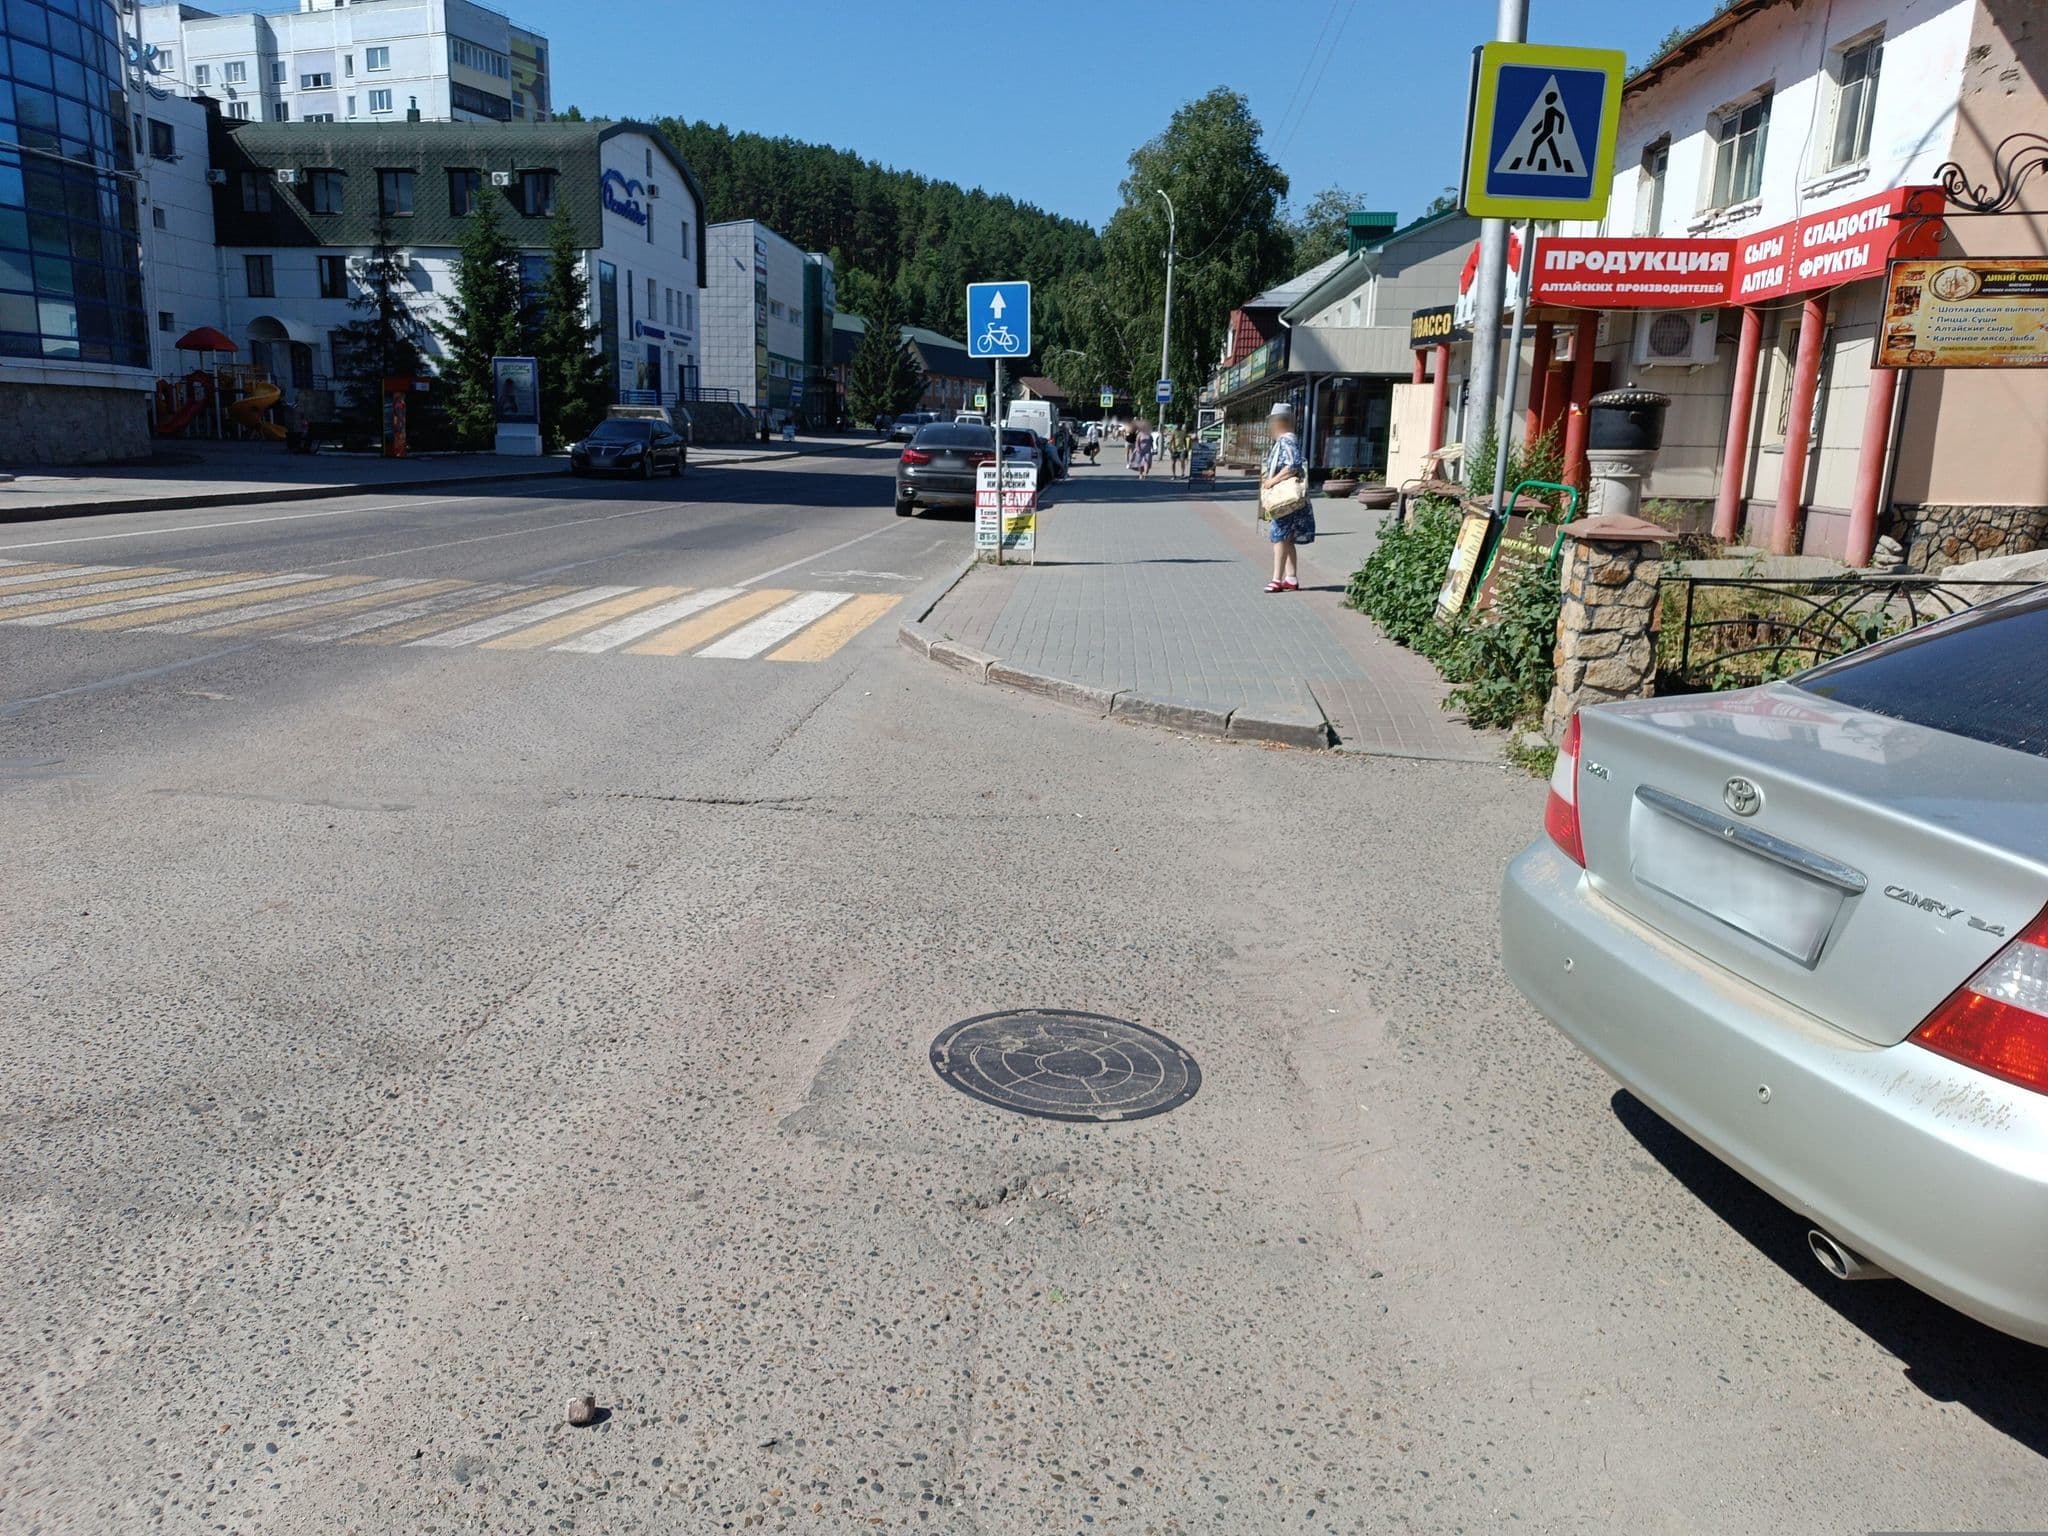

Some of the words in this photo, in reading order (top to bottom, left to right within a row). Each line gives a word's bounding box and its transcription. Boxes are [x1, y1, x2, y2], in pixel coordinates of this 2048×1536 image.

[1803, 203, 1892, 248] СЛАДОСТИ
[1544, 250, 1730, 274] ПРОДУКЦИЯ
[1744, 235, 1785, 265] СЫРЫ
[1798, 243, 1870, 280] ФРУКТЫ
[1540, 281, 1613, 292] АЛТАЙСКИХ
[1616, 282, 1724, 294] ПРОИЗВОДИТЕЛЕЙ
[1740, 265, 1785, 294] АЛТАЯ
[1984, 272, 2016, 281] ДИКИЙ
[1884, 885, 1964, 919] CAMRY
